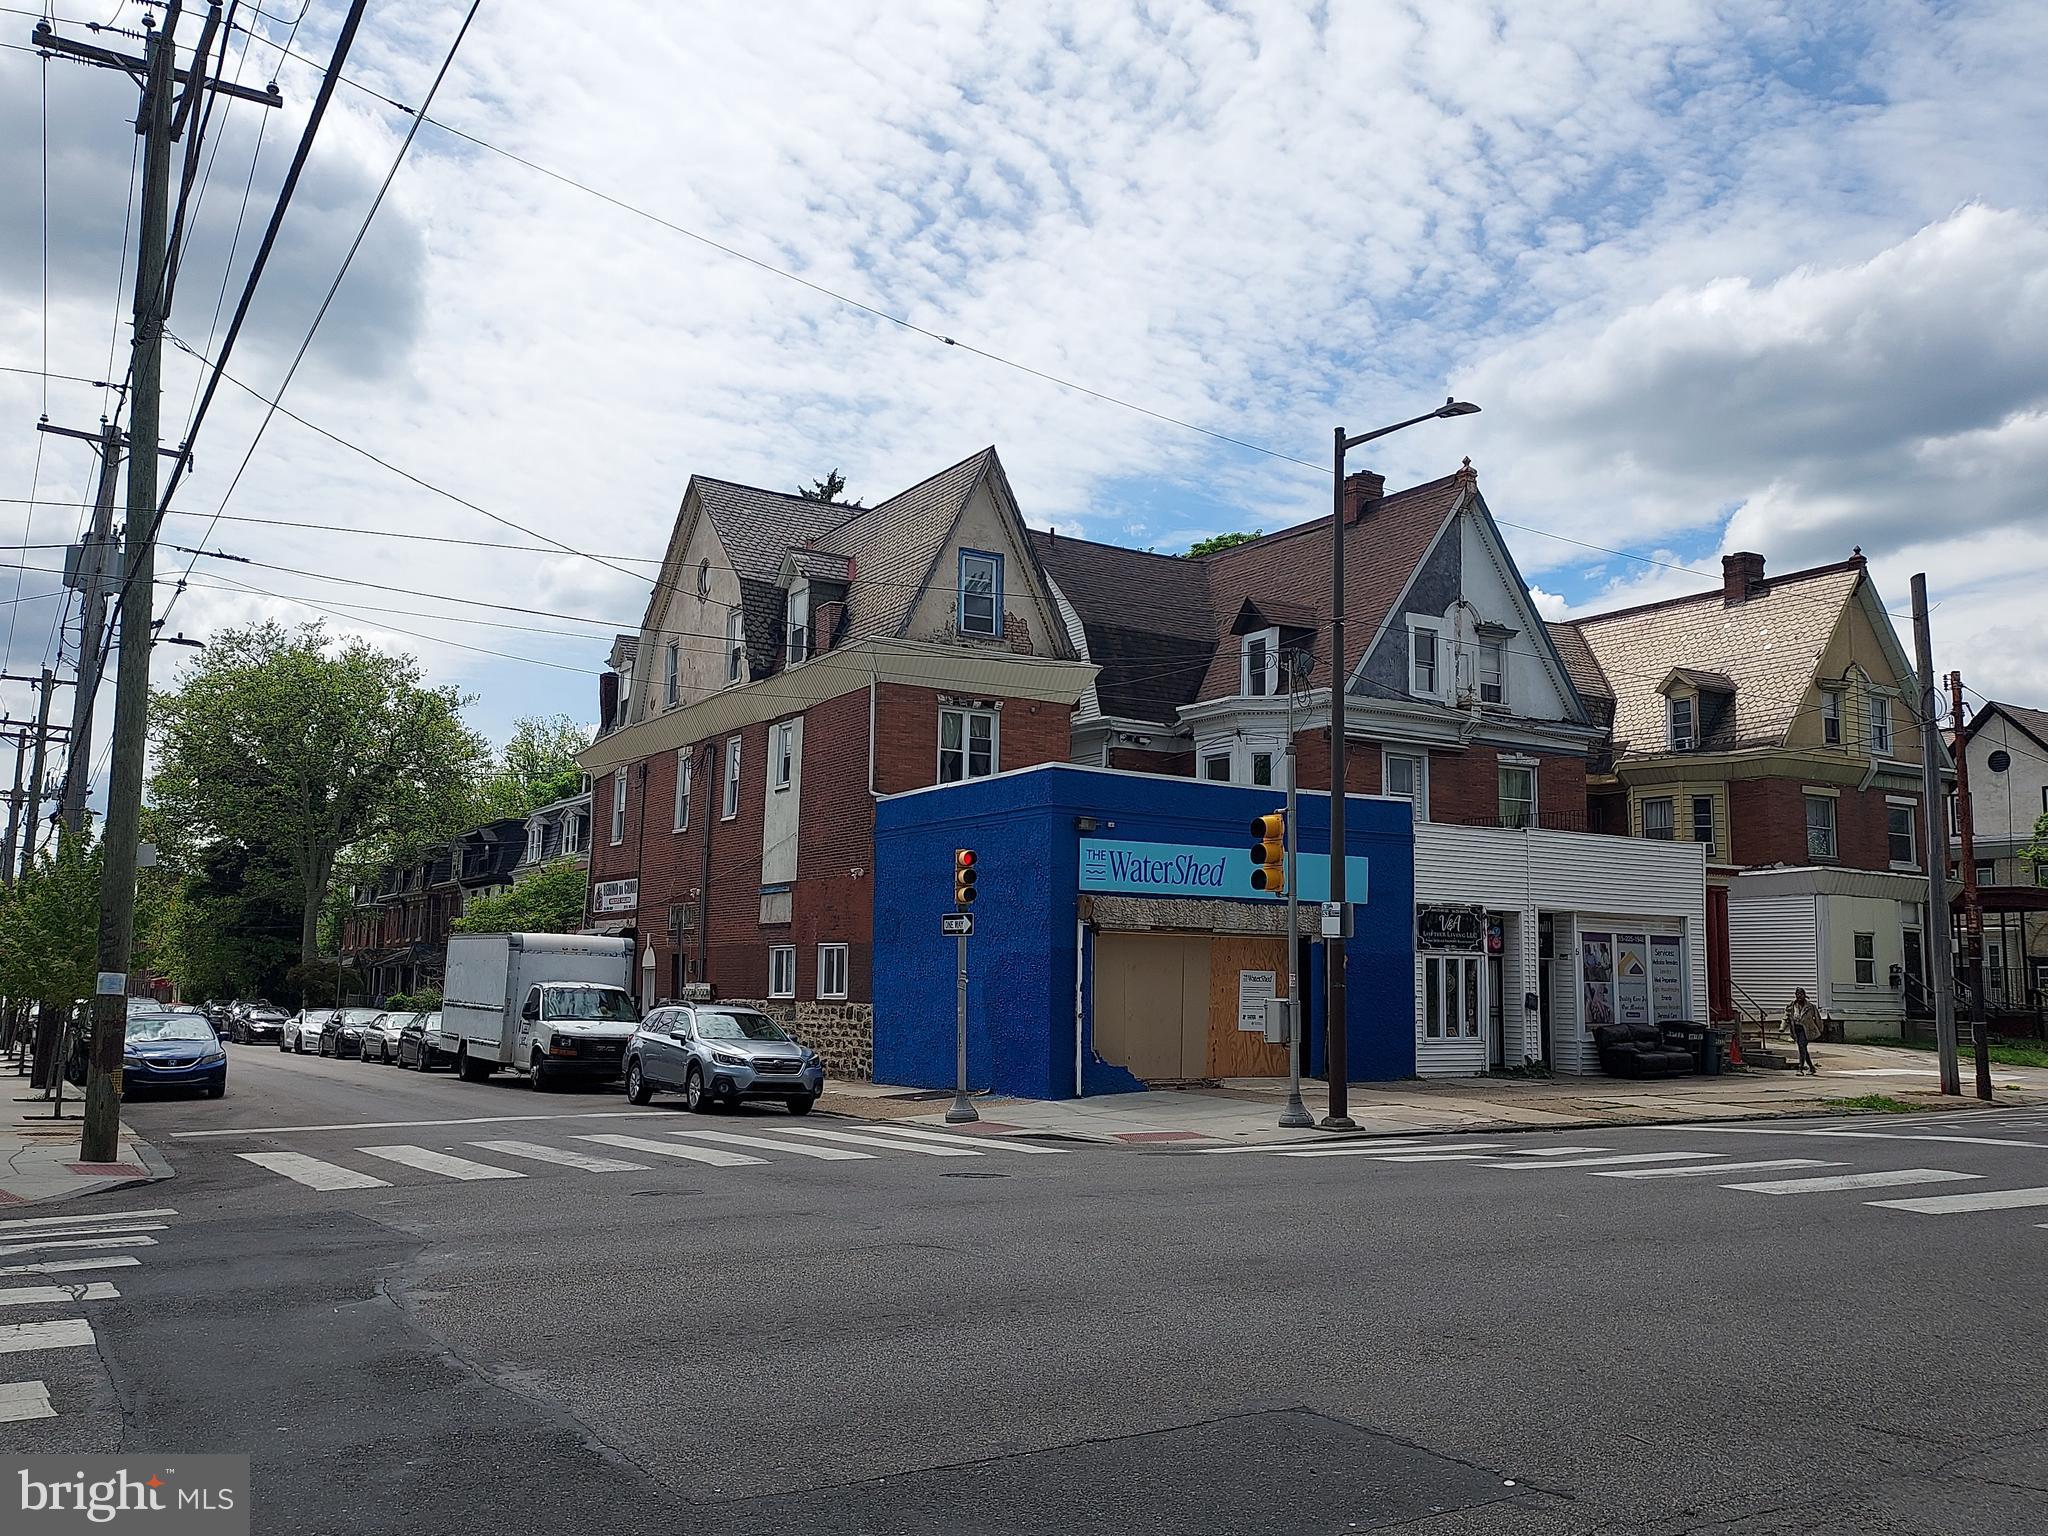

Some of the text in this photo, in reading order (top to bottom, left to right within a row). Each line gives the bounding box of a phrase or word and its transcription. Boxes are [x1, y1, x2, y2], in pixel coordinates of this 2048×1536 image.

[1086, 849, 1227, 887] THE WaterShed
[945, 920, 964, 929] ONE WAY
[1439, 914, 1461, 932] V&A
